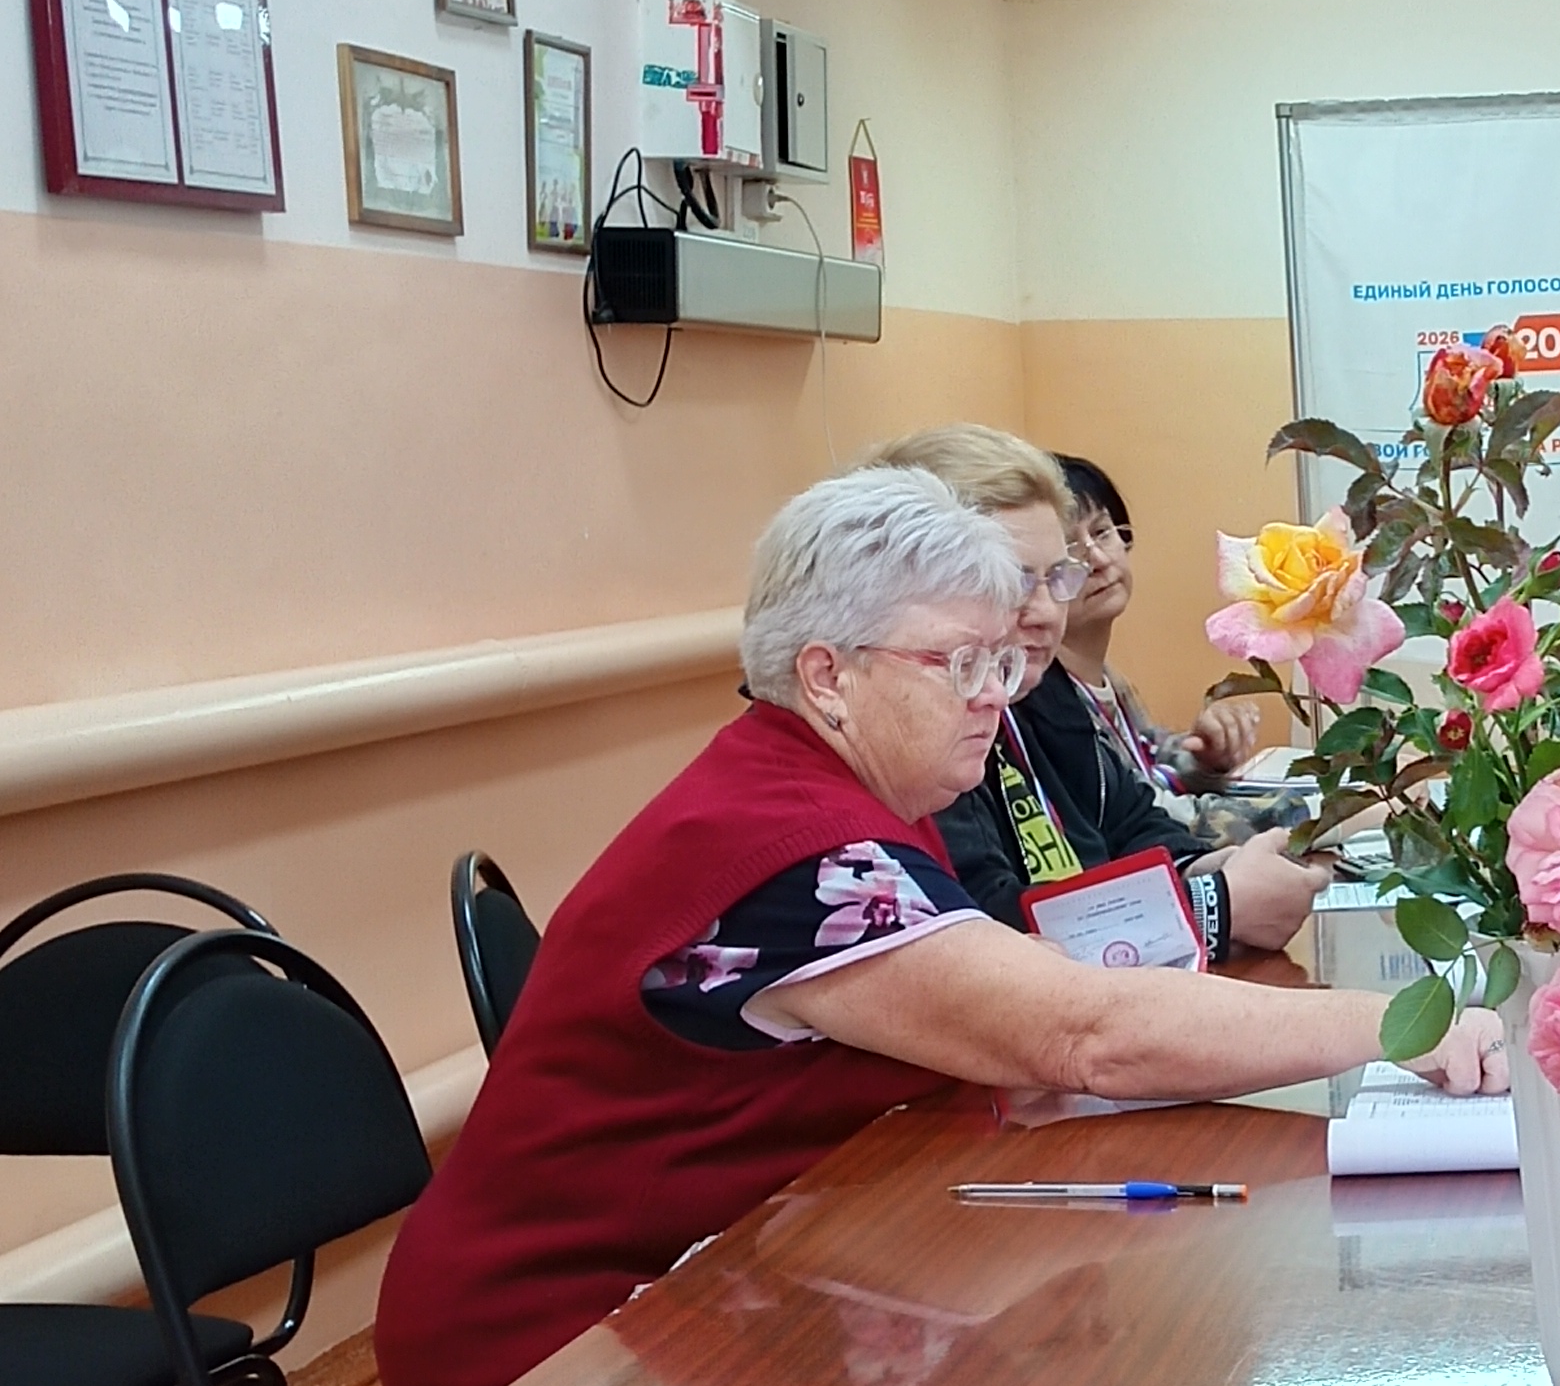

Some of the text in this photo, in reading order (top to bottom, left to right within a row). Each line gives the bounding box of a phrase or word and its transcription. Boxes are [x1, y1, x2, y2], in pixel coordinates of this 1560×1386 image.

[1353, 280, 1431, 301] ЕДИНЫЙ
[1436, 283, 1483, 300] ДЕНЬ
[1417, 330, 1460, 346] 2026
